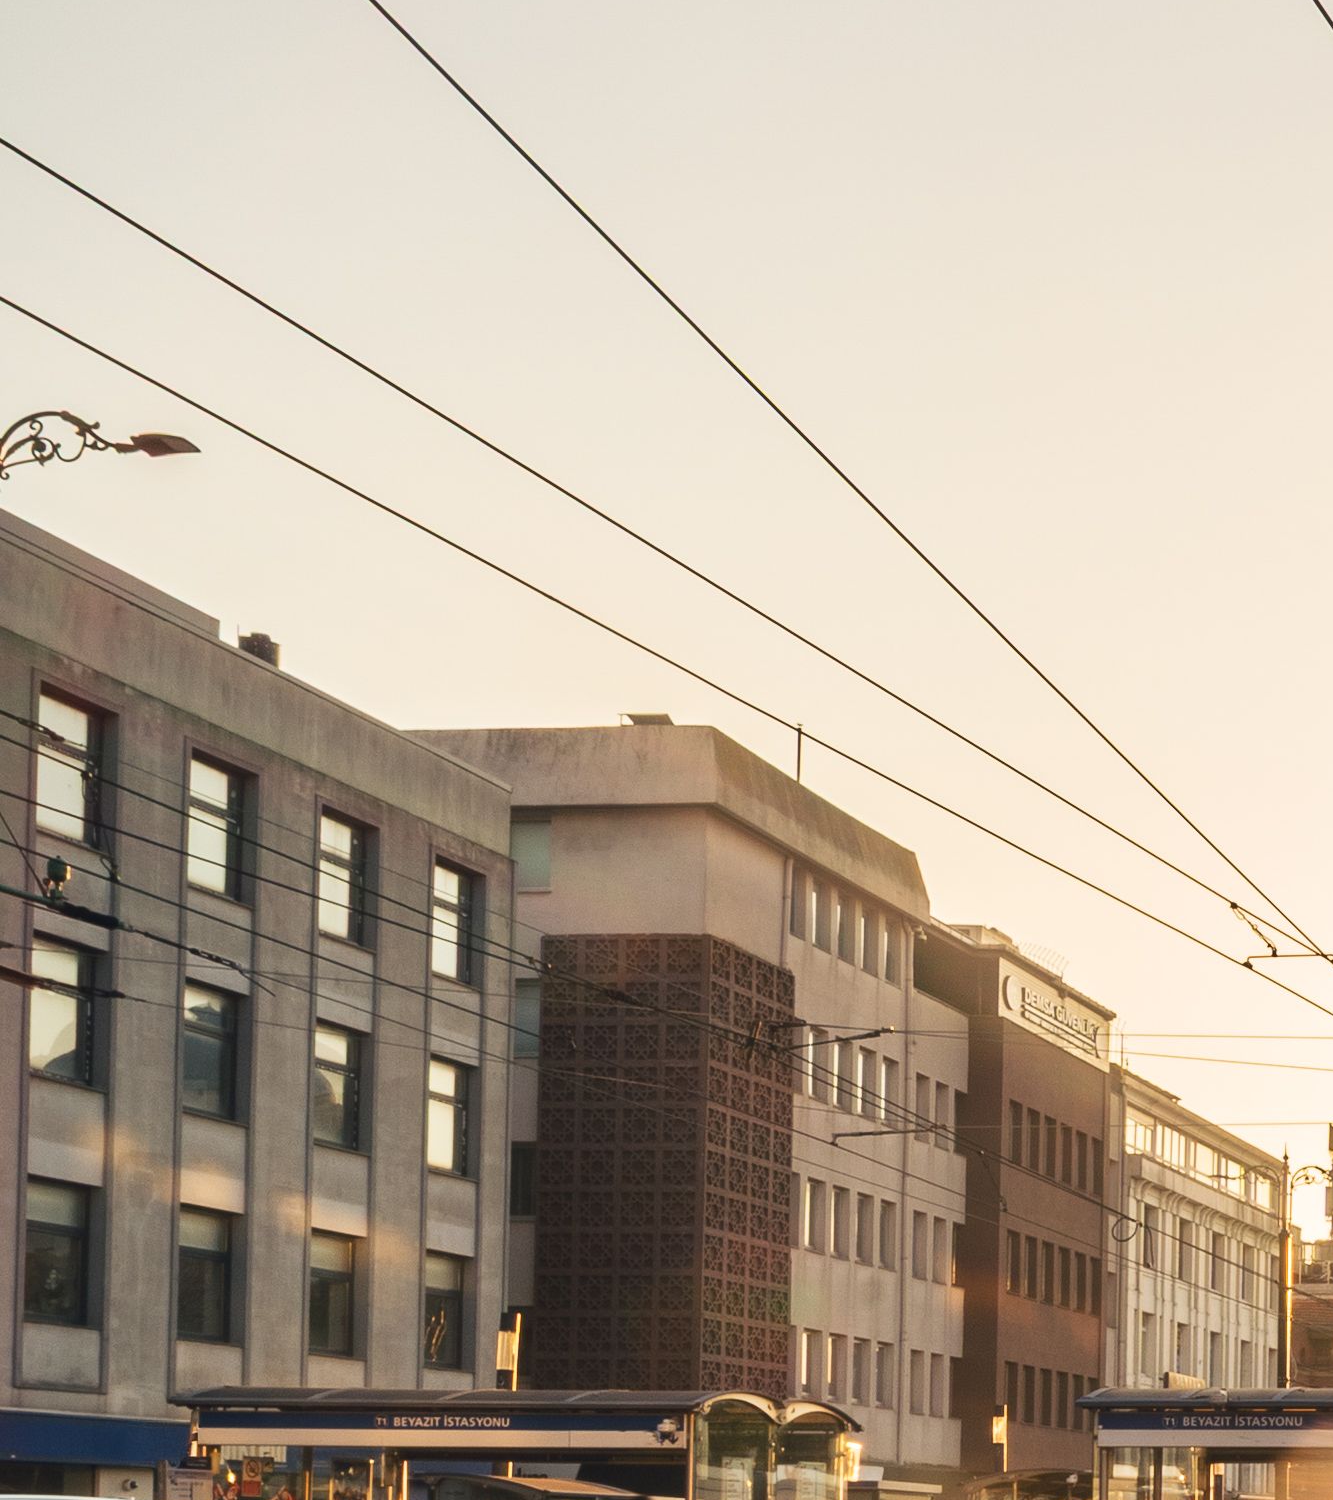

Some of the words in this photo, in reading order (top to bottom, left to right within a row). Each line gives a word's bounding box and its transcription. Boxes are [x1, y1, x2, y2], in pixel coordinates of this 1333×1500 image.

[376, 1416, 387, 1426] T1
[393, 1416, 441, 1427] BEYAZIT
[443, 1414, 510, 1428] İSTASYONU
[1165, 1416, 1176, 1426] T1
[1182, 1416, 1231, 1427] BEYAZIT
[1235, 1414, 1304, 1427] İSTASYONU
